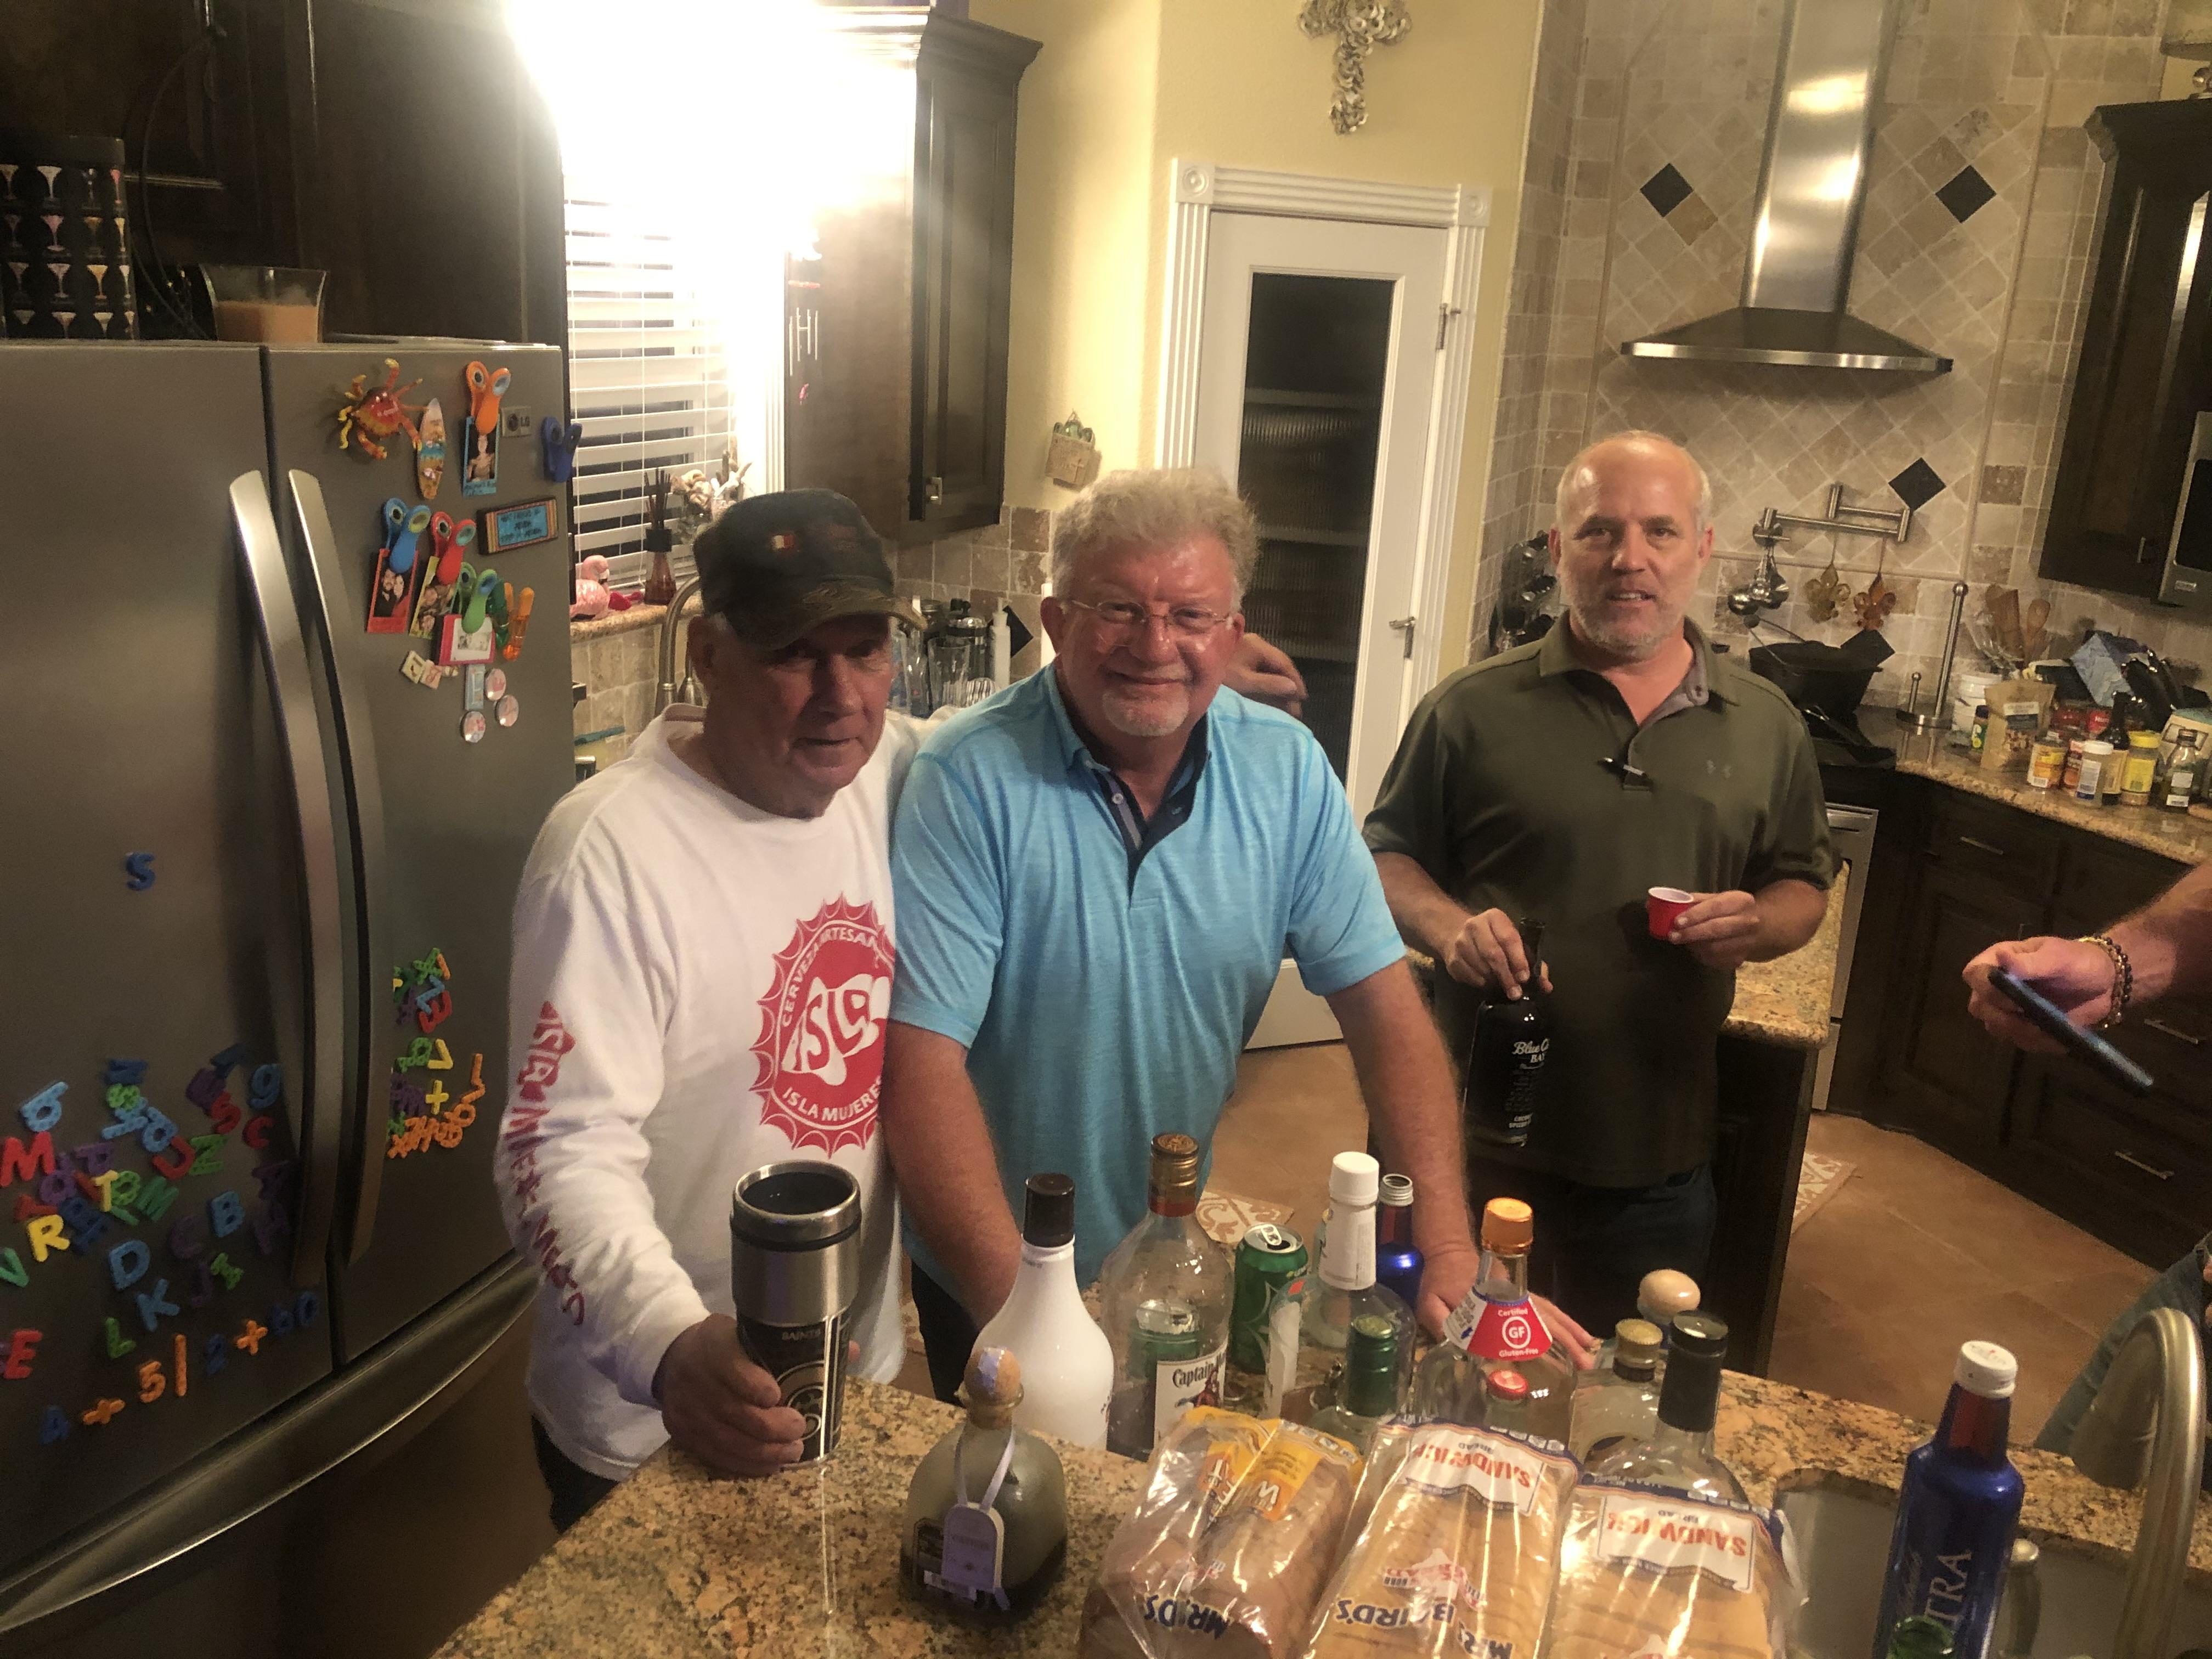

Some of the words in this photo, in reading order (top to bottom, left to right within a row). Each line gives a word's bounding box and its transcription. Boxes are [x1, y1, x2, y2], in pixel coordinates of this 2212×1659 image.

[125, 852, 156, 891] S
[1512, 1040, 1541, 1054] Blue
[783, 1086, 818, 1120] ISLA
[0, 1131, 56, 1187] M
[93, 1170, 119, 1212] T
[210, 1190, 246, 1238] B
[28, 1214, 70, 1262] R
[110, 1239, 151, 1290] D
[136, 1279, 180, 1331] K
[1498, 1308, 1528, 1317] Certified
[105, 1317, 137, 1359] L
[1499, 1348, 1539, 1358] Gluten-Free
[1509, 1326, 1525, 1339] GF
[3, 1329, 43, 1379] E
[1172, 1362, 1214, 1387] Captain
